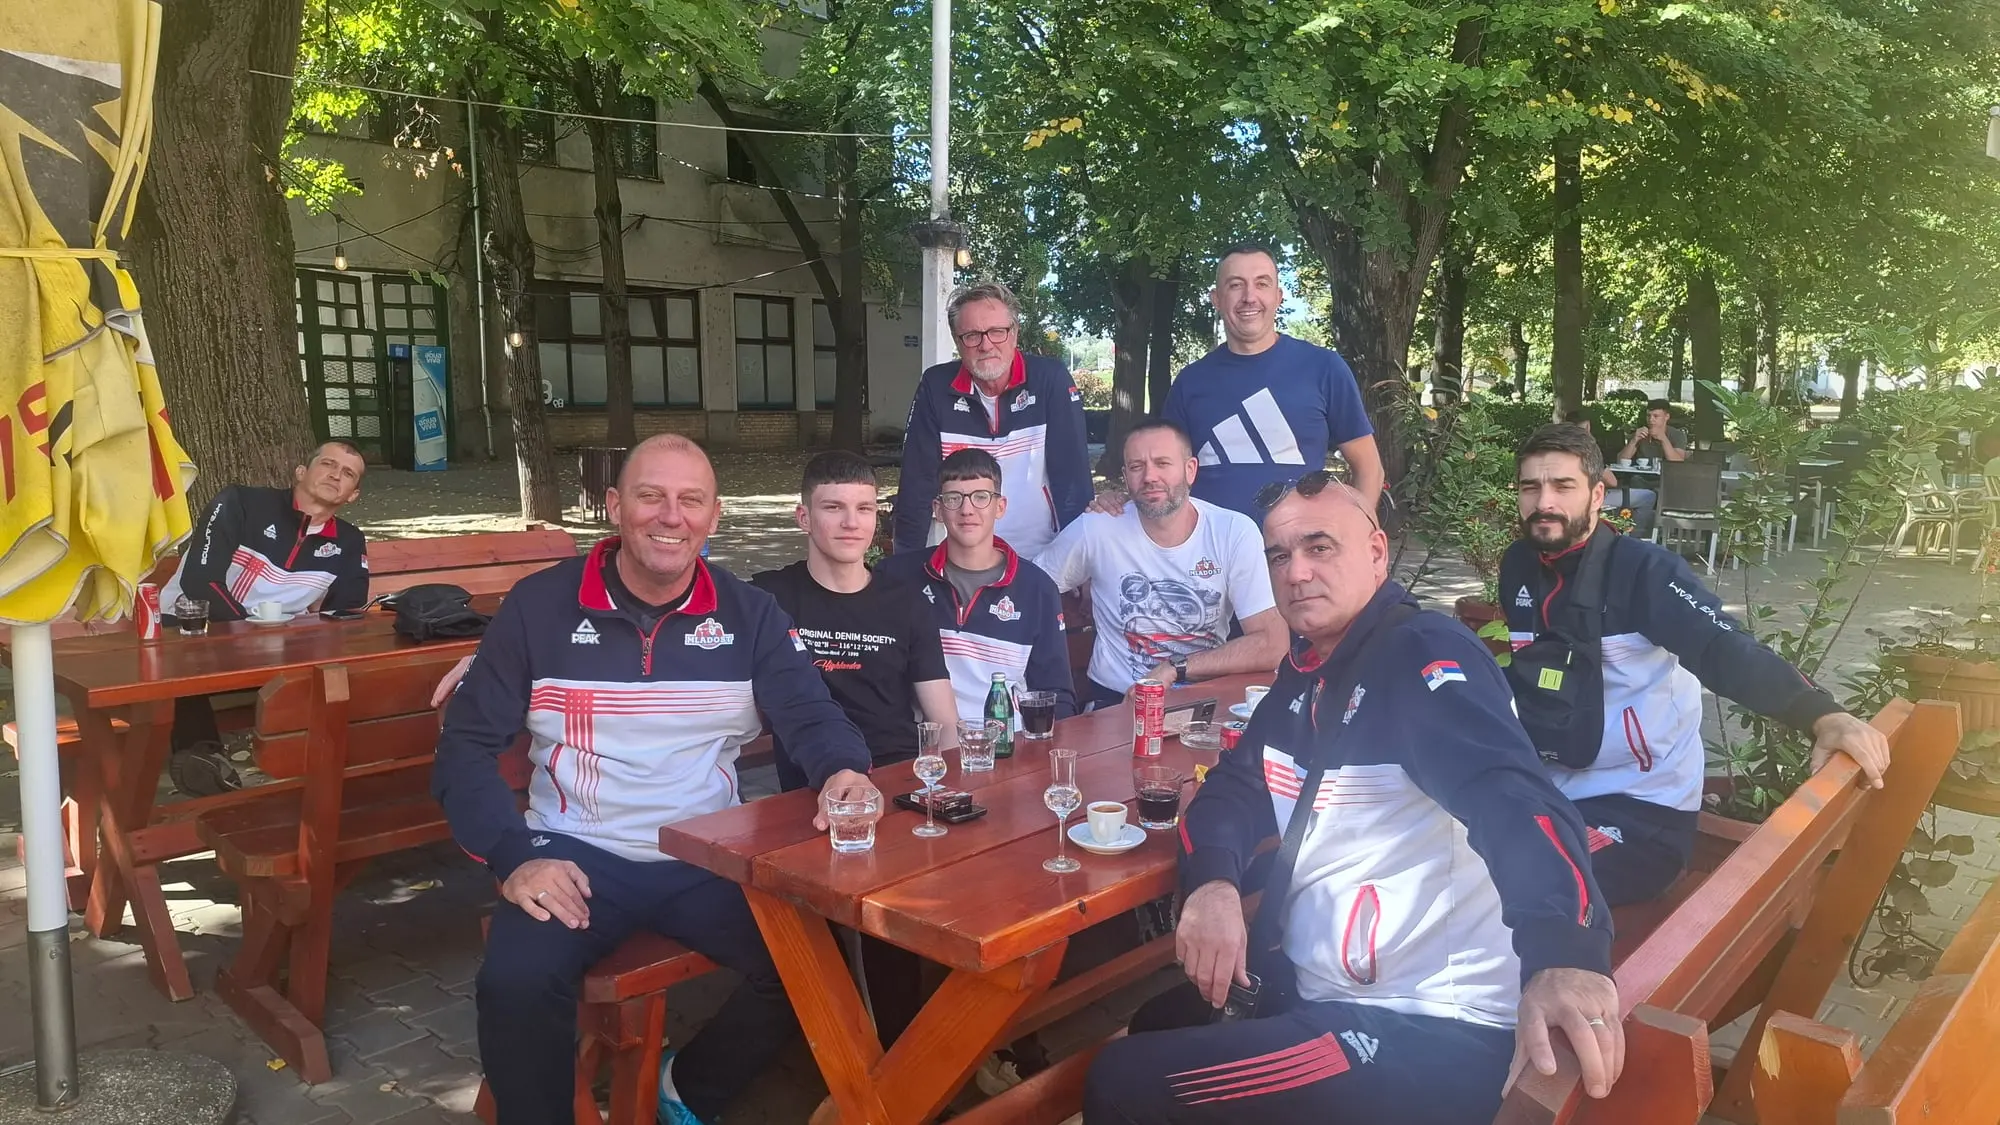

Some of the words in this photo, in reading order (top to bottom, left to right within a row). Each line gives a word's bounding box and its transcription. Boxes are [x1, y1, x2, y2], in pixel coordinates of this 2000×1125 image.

[1667, 581, 1698, 609] TEAM
[571, 632, 601, 644] PEAK
[687, 635, 733, 645] MLADOST
[835, 631, 861, 642] DENIM
